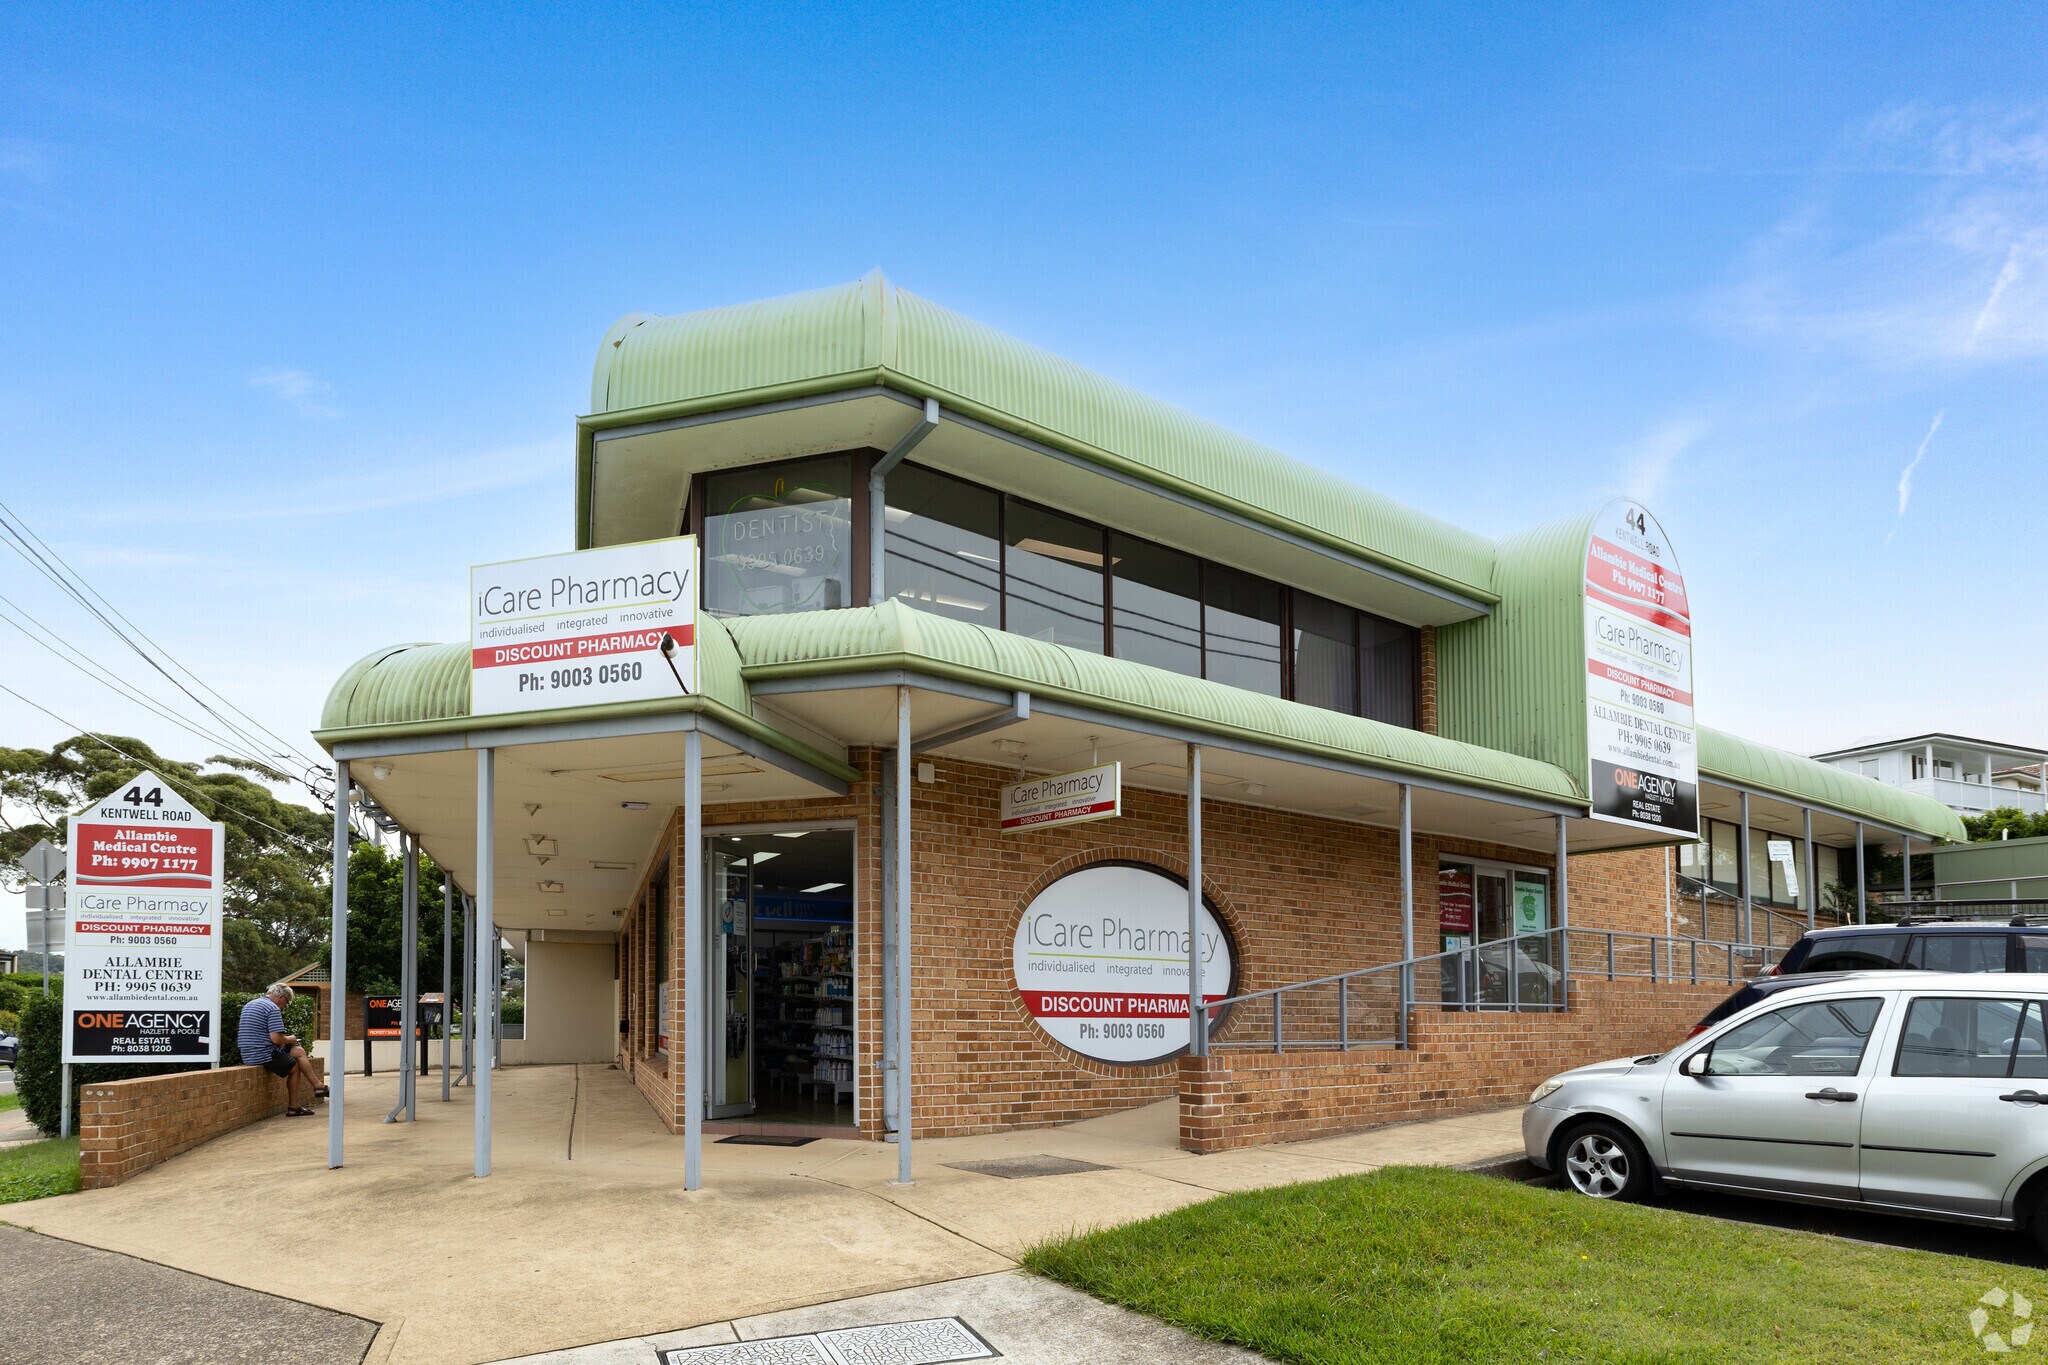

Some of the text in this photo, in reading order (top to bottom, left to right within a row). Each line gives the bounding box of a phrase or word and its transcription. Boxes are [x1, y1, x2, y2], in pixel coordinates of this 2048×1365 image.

[734, 510, 829, 541] DENTIST
[1626, 508, 1646, 536] 44
[783, 545, 825, 565] 0639
[1645, 541, 1660, 557] ROAD
[1591, 543, 1627, 570] Allambie
[1628, 560, 1658, 584] Medical
[478, 568, 690, 617] iCare Pharmacy
[1612, 569, 1665, 604] Ph: 9907 1177
[479, 607, 674, 639] individualised integrated innovative
[495, 642, 574, 664] DISCOUNT
[1594, 616, 1684, 672] iCare Pharmacy
[519, 661, 642, 692] Ph: 9003 0560
[1606, 668, 1676, 698] DISCOUNT PHARMACY
[1620, 690, 1664, 714] Ph: 9003 0560
[1593, 705, 1692, 745] ALLAMBIE DENTAL CENTRE
[1618, 728, 1672, 755] PH: 9905 0639
[124, 786, 164, 807] 44
[1010, 774, 1104, 804] iCare Pharmacy
[100, 807, 192, 822] KENTWELL ROAD
[1011, 796, 1096, 816] individualised integrated innovative
[1020, 806, 1092, 825] DISCOUNT PHARMACY
[1632, 800, 1661, 814] REAL ESTATE
[114, 829, 177, 842] Allambie
[93, 840, 197, 855] Medical Centre
[92, 854, 198, 871] Ph: 9907 1177
[80, 895, 208, 916] iCare Pharmacy
[130, 914, 162, 922] integrated
[81, 924, 205, 934] DISCOUNT PHARMACY
[1027, 914, 1219, 963] iCare Pharmay
[110, 935, 177, 946] Ph: 9003 0560
[104, 956, 182, 968] ALLAMBIE
[1028, 959, 1206, 978] individualised integrated innovae
[82, 968, 203, 980] DENTAL CENTRE
[94, 981, 192, 992] PH: 9905 0639
[86, 994, 198, 1002] www.allambiedental.com.au
[1041, 996, 1208, 1014] DISCOUNT PHARMA
[112, 1036, 170, 1045] REAL ESTATE
[1080, 1023, 1165, 1040] Ph: 9003 0560
[111, 1044, 125, 1052] Ph:
